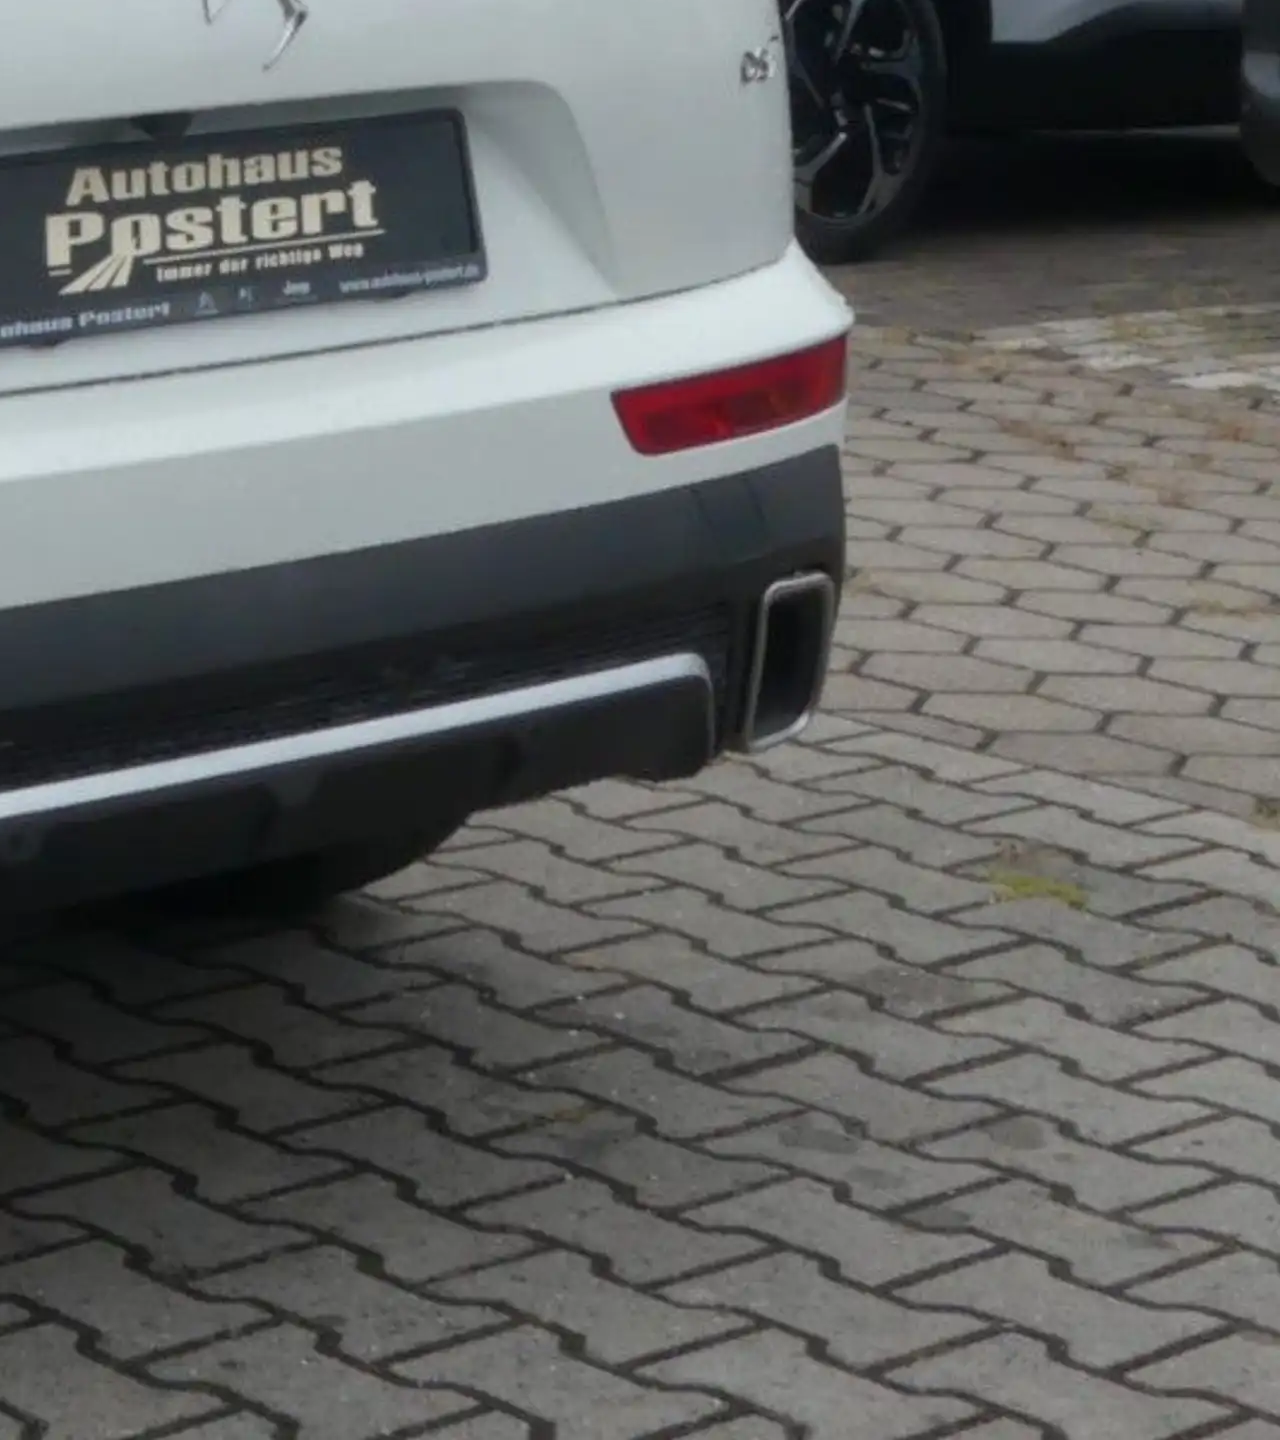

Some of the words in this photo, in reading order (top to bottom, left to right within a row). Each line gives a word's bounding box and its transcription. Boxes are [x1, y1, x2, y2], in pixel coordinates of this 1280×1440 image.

[66, 144, 343, 207] Autohaus
[44, 178, 381, 269] Postert
[327, 241, 366, 262] Weg
[78, 300, 171, 329] Postert
